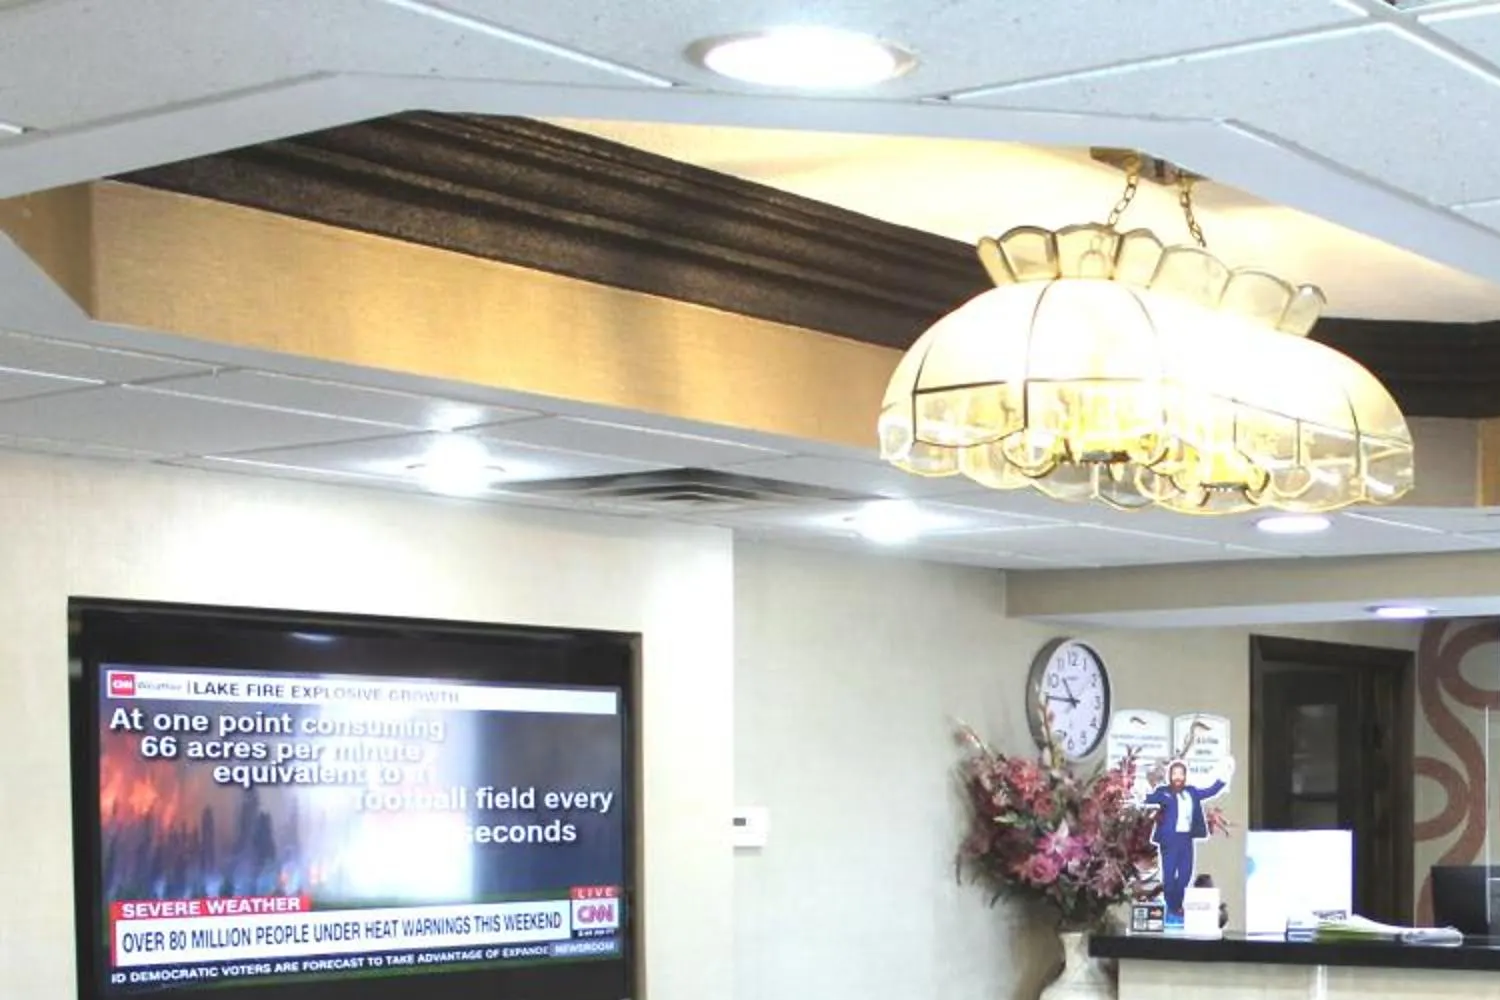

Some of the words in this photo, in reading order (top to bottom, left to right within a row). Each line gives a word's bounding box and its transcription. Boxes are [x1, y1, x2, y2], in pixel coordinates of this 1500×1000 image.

[1067, 651, 1080, 667] 12
[193, 681, 240, 696] LAKE
[247, 683, 285, 698] FIRE
[291, 685, 381, 701] EXPLOSIVE
[388, 689, 459, 703] GROWTH
[110, 707, 143, 729] At
[153, 713, 209, 731] one
[219, 711, 292, 737] point
[302, 713, 445, 742] consuming
[141, 736, 177, 757] 66
[187, 740, 267, 759] acres
[277, 742, 326, 763] per
[334, 741, 423, 762] minute
[213, 761, 367, 788] equivalent
[476, 786, 536, 809] field
[544, 789, 613, 813] every
[121, 900, 200, 918] SEVERE
[206, 897, 300, 915] WEATHER
[577, 904, 614, 923] CNN
[122, 931, 164, 953] OVER
[169, 931, 187, 950] 80
[191, 927, 251, 949] MILLION
[256, 923, 309, 945] PEOPLE
[313, 921, 360, 942] UNDER
[365, 919, 399, 939] HEAT
[401, 915, 471, 937] WARNINGS
[474, 914, 501, 932] THIS
[503, 911, 562, 931] WEEKEND
[130, 966, 218, 982] DEMOCRATIC
[222, 963, 271, 977] VOTERS
[274, 961, 299, 973] ARE
[302, 956, 364, 972] FORECAST
[367, 957, 383, 967] TO
[385, 954, 415, 966] TAKE
[417, 950, 483, 964] ADVANTAGE
[485, 949, 499, 959] OF
